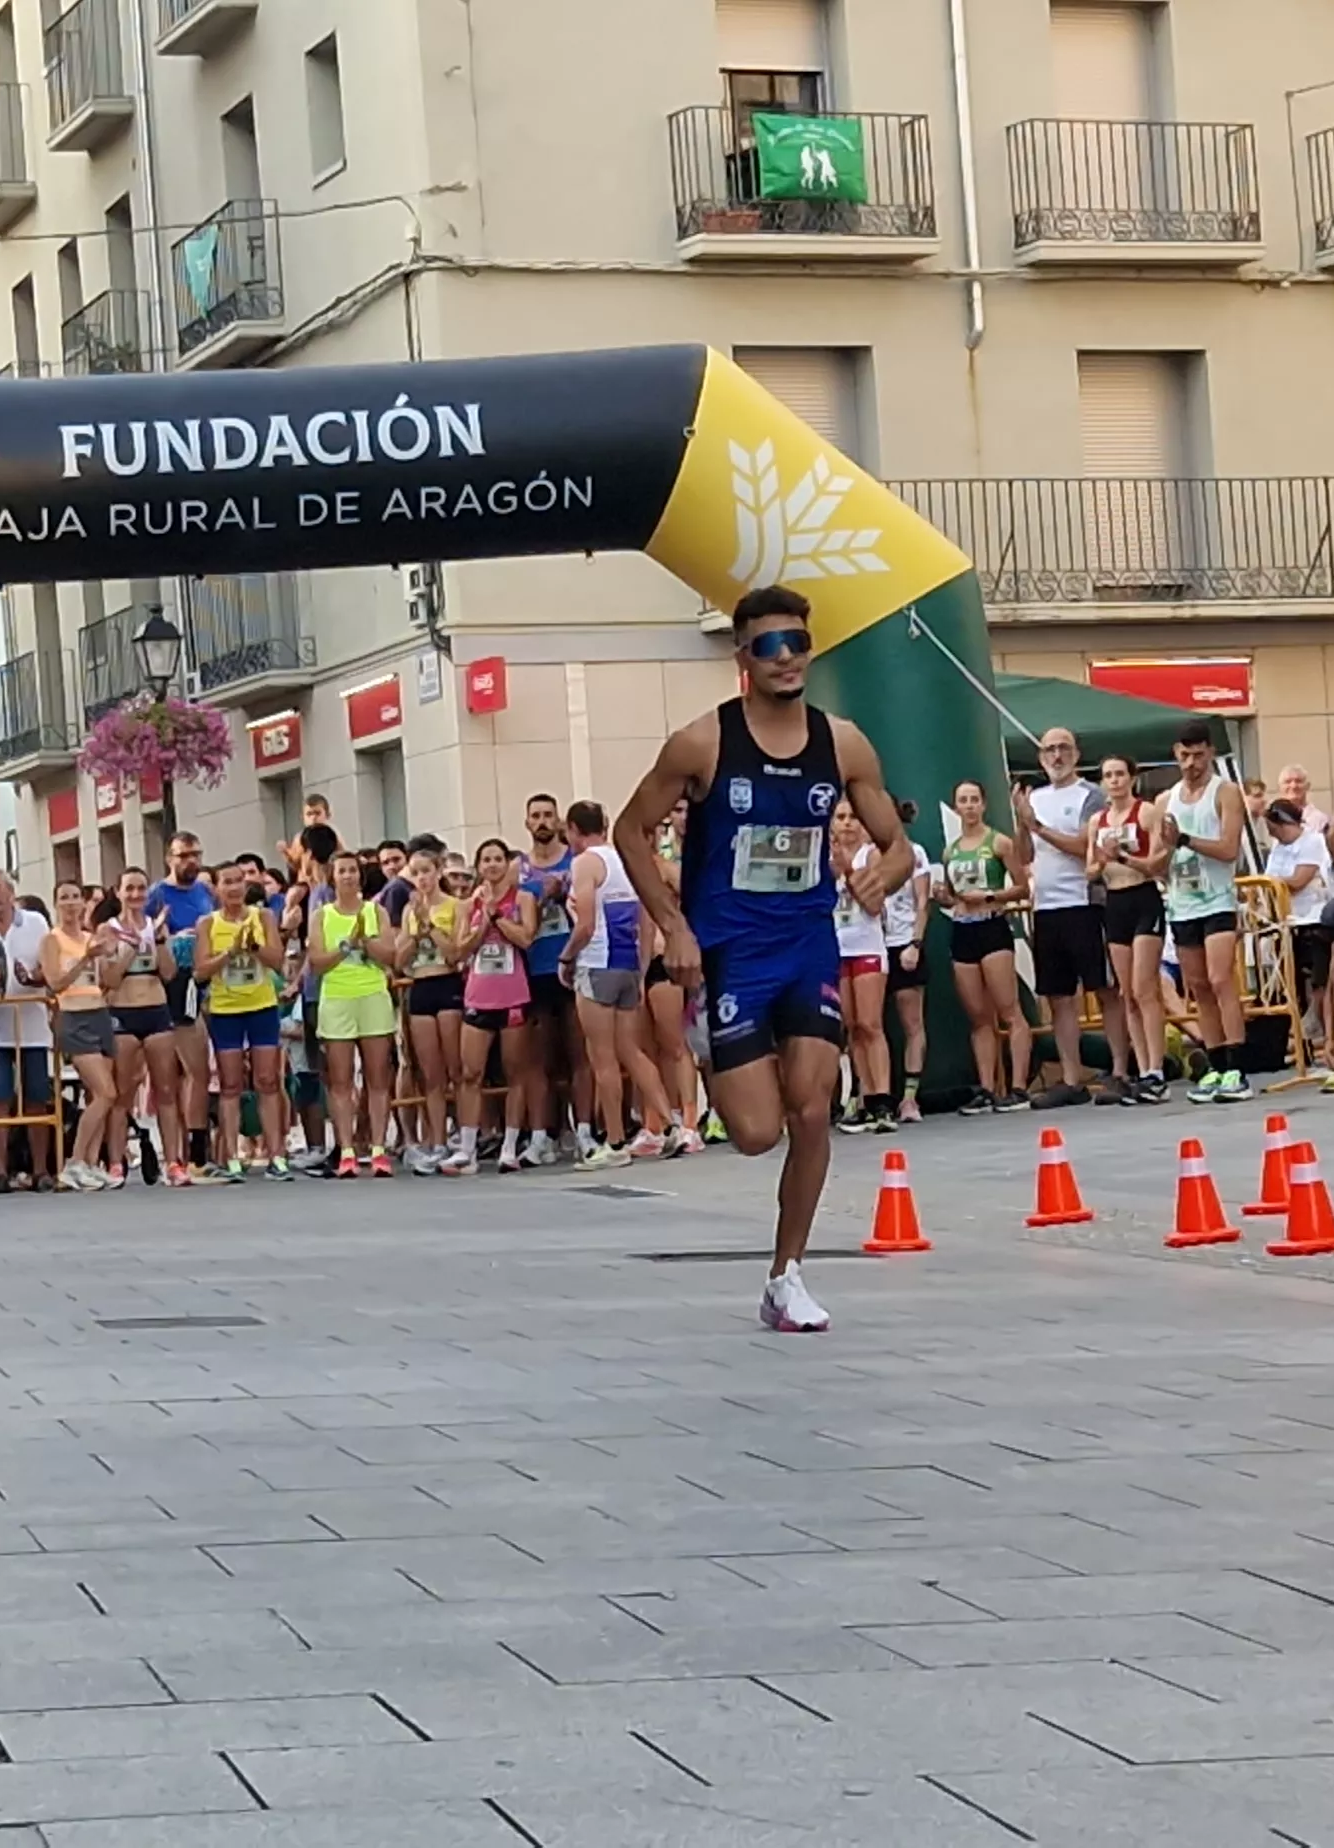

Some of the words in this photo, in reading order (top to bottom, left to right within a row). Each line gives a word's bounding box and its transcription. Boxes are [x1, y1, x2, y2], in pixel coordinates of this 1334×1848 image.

[60, 393, 485, 478] FUNDACIÓN
[109, 496, 277, 536] RURAL
[298, 493, 361, 527] DE
[382, 471, 594, 520] ARAGÓN
[775, 831, 791, 851] 6
